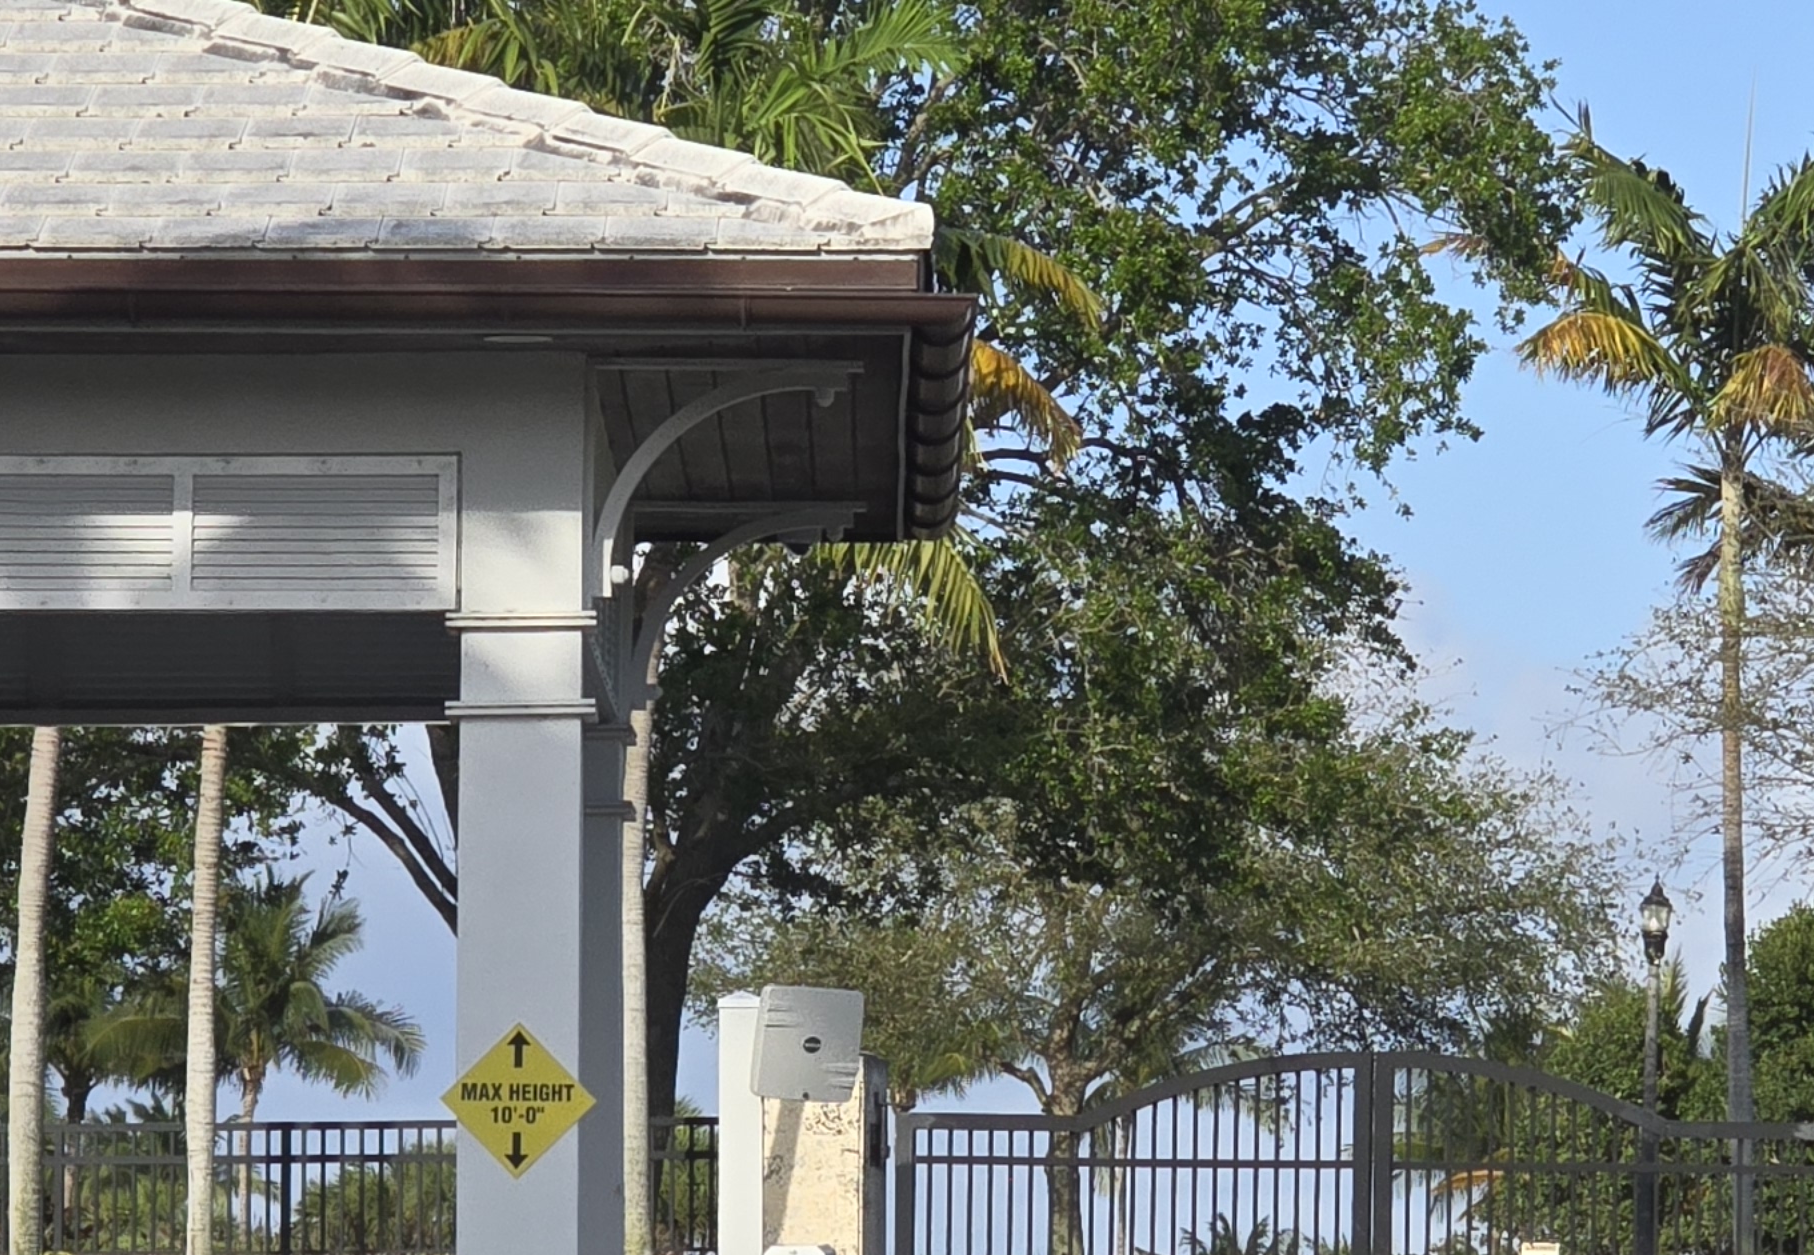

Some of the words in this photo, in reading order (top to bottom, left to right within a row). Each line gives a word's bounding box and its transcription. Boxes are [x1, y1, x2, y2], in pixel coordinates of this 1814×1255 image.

[461, 1082, 503, 1101] MAX
[509, 1083, 575, 1102] HEIGHT
[490, 1106, 545, 1124] 10'-0"
